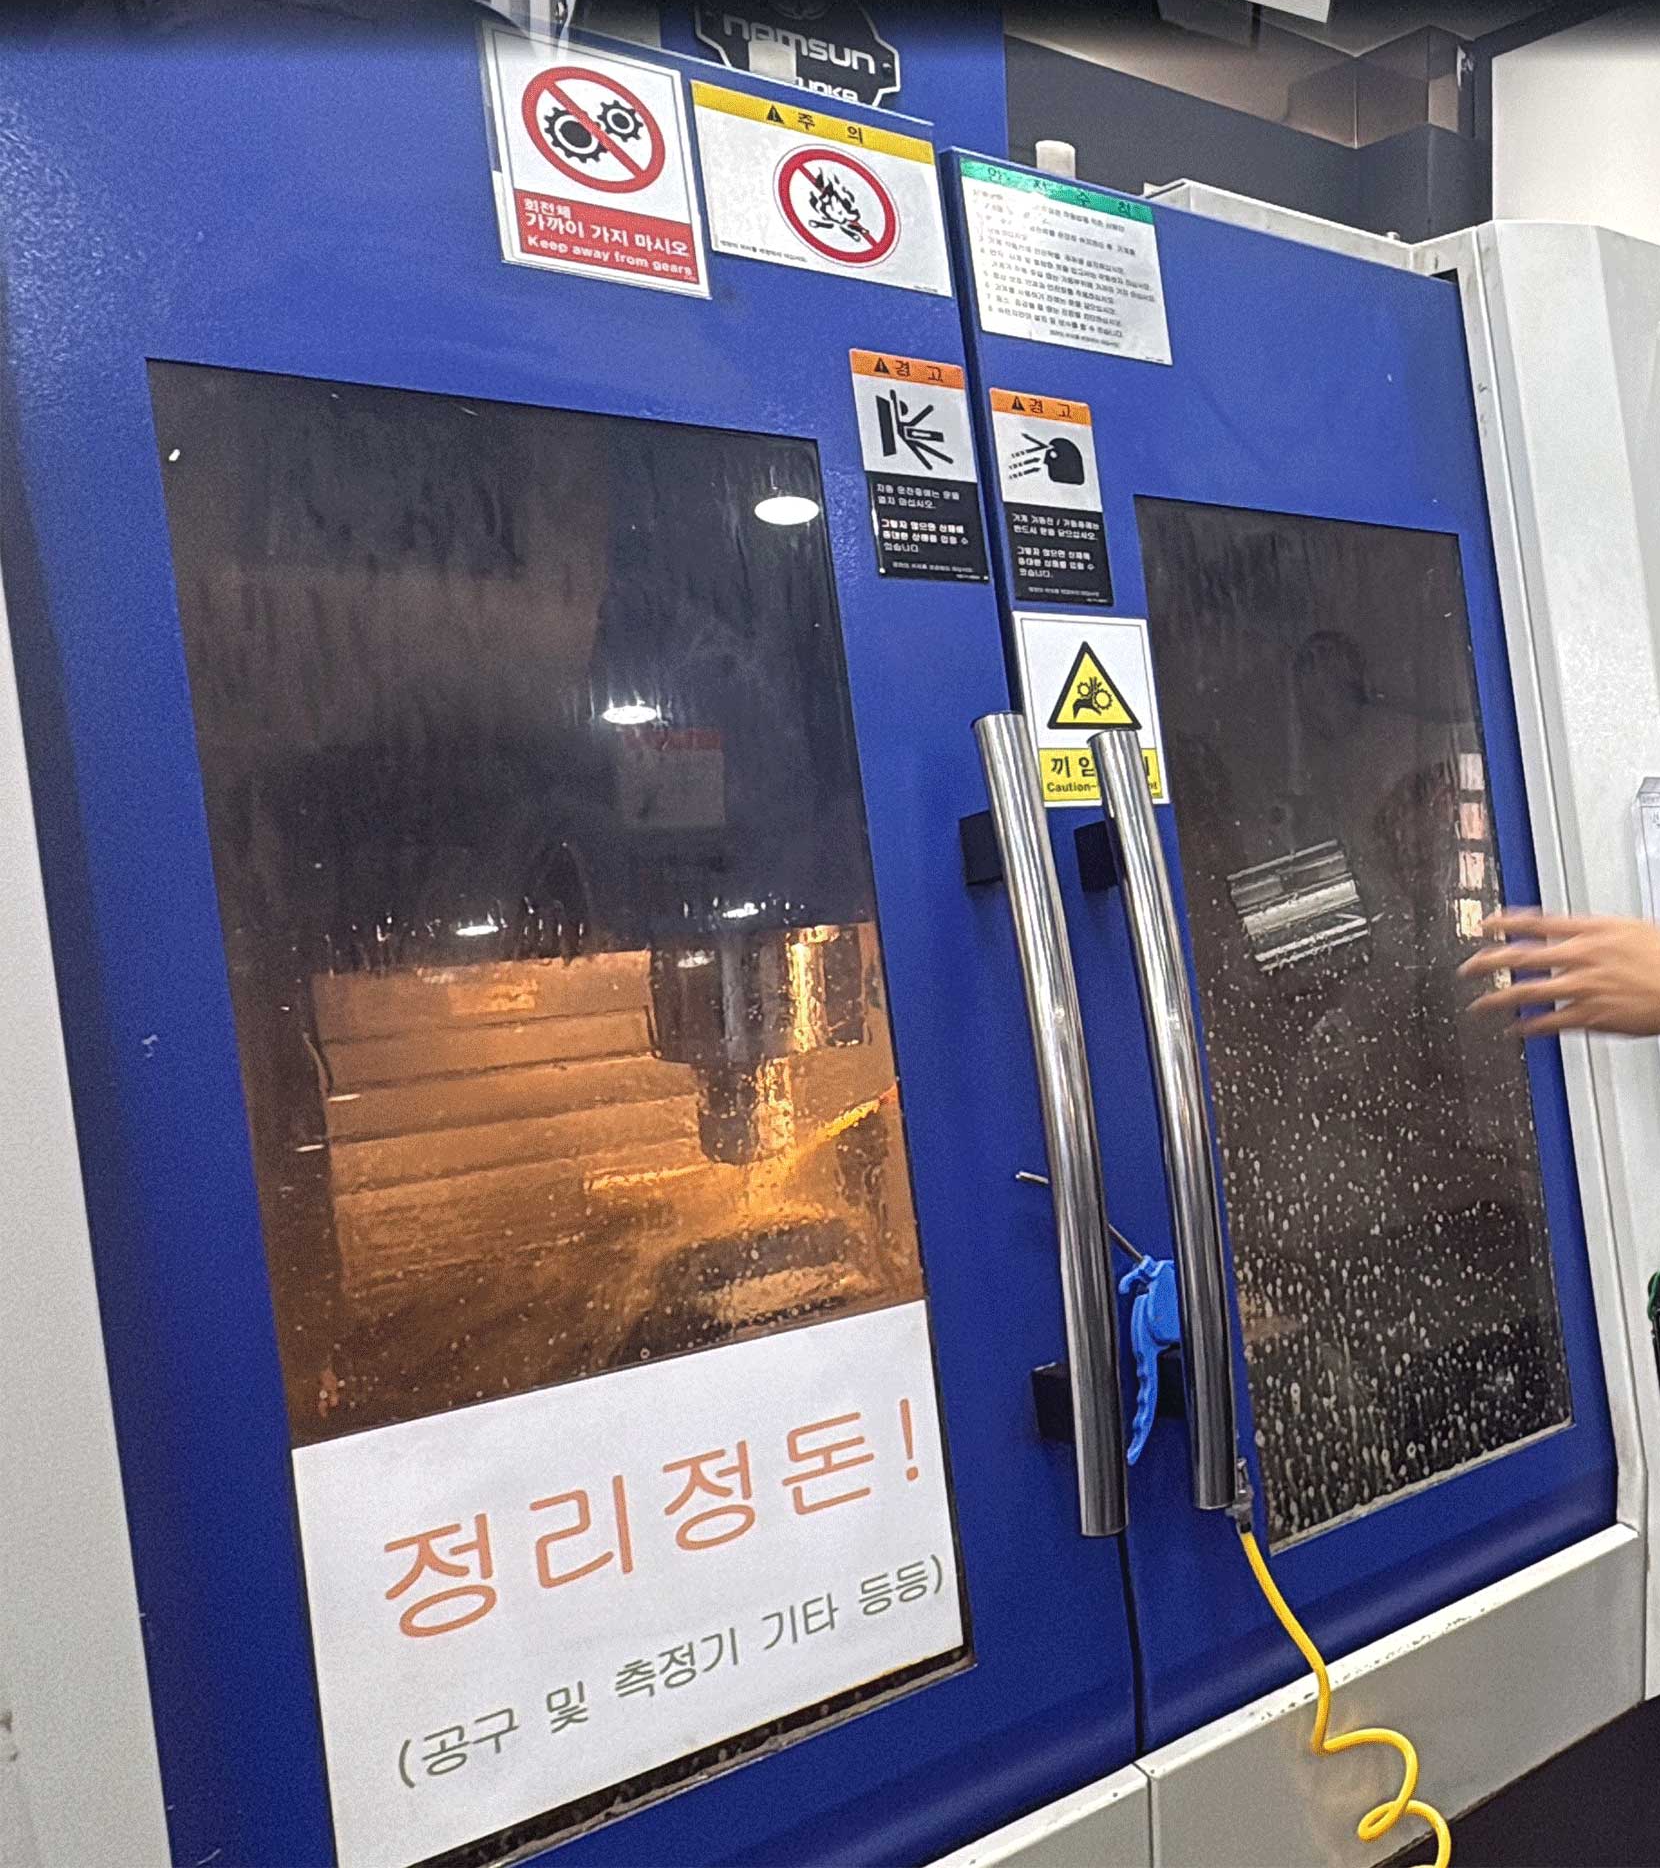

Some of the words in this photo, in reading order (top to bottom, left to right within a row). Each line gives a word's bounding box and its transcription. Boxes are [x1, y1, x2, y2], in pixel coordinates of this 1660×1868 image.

[524, 198, 572, 220] 회전체
[525, 212, 585, 238] 가까이
[590, 224, 628, 247] 가지
[634, 233, 689, 257] 마시오
[527, 236, 568, 254] Keep
[572, 245, 610, 263] away
[614, 251, 649, 268] from
[652, 260, 693, 275] gears
[383, 1398, 920, 1639] 정리정돈!
[397, 1707, 519, 1789] (공구
[546, 1680, 590, 1733] 및
[614, 1627, 739, 1699] 측정기
[762, 1593, 839, 1651] 기타
[859, 1554, 945, 1617] 등등)
